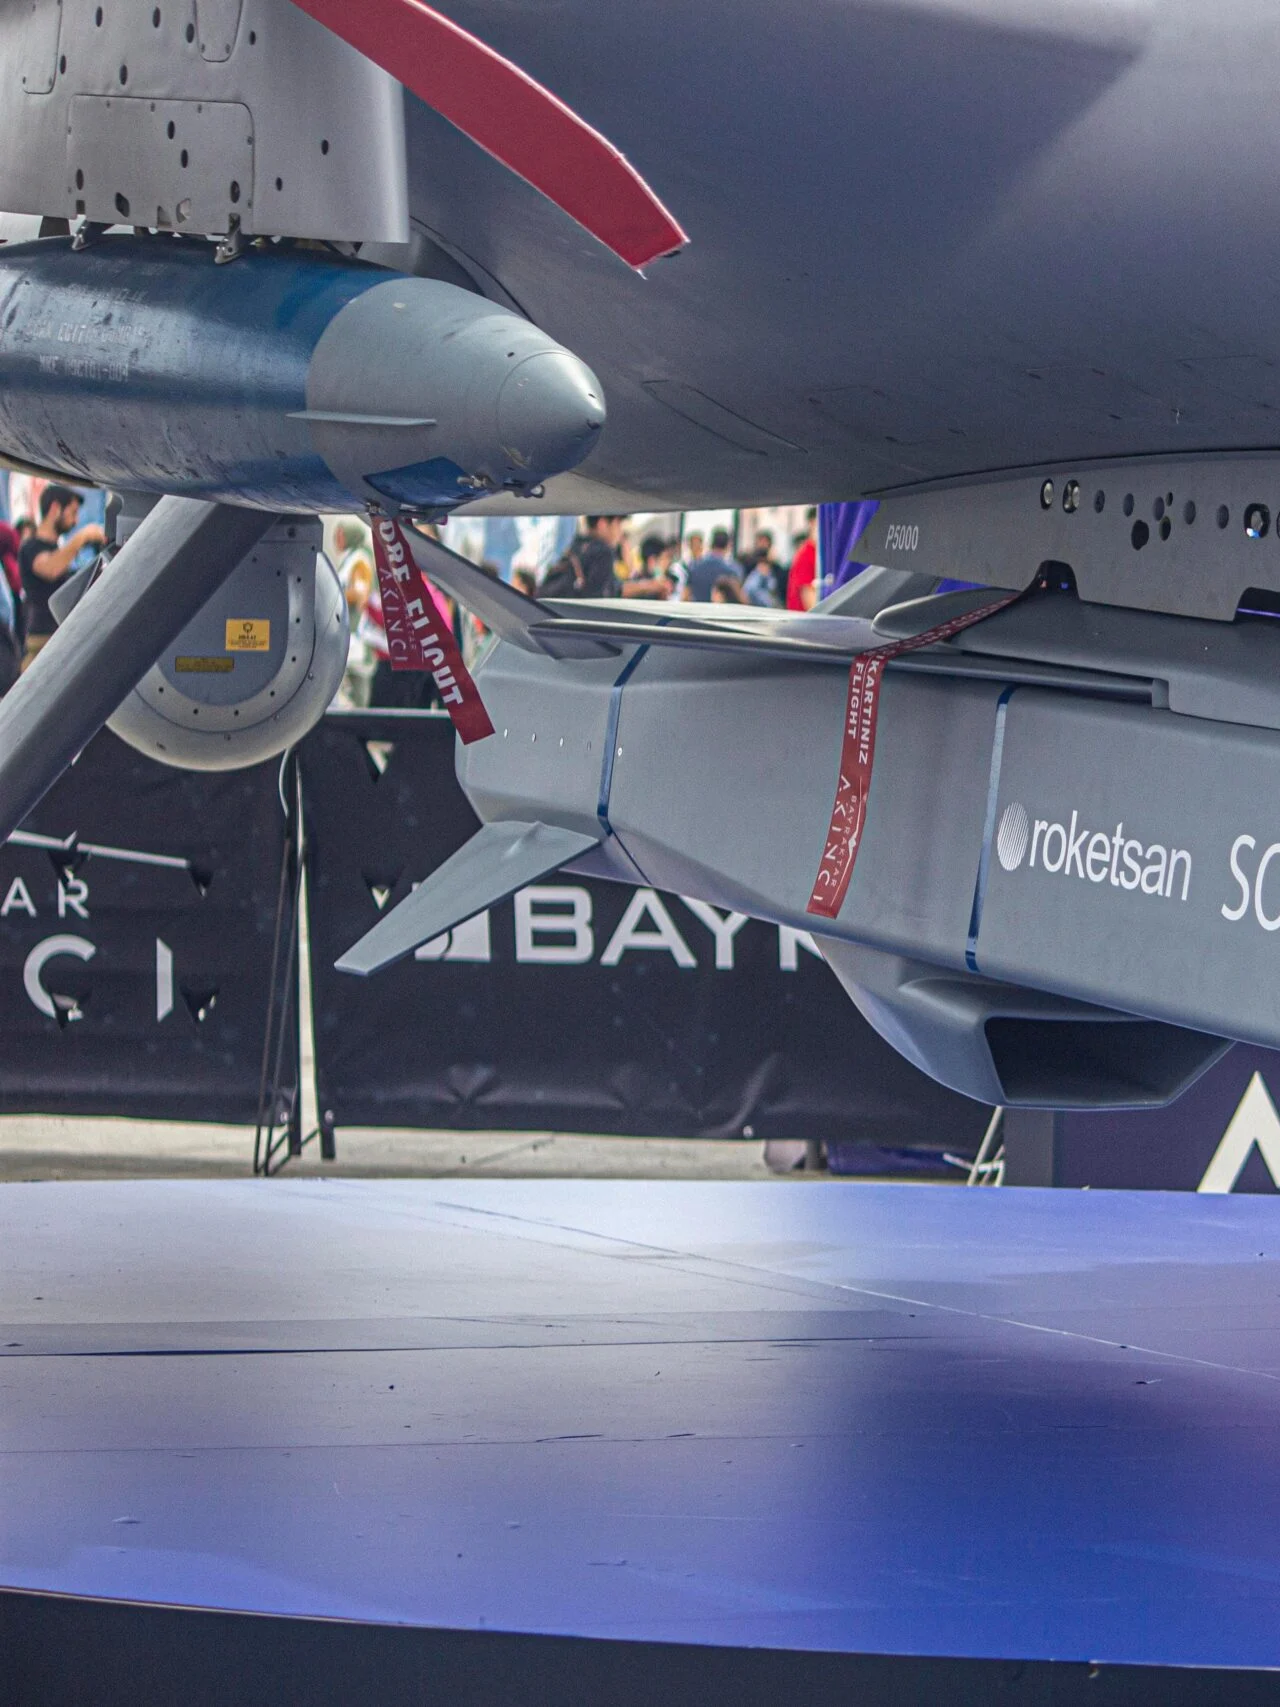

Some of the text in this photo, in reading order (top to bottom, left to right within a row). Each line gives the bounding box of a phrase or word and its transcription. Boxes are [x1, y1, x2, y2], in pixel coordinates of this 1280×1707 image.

[885, 524, 919, 551] P5000
[848, 662, 865, 740] FLIGHT
[813, 775, 851, 900] AKINCI
[831, 795, 857, 887] BAYRAKTAR
[1029, 810, 1192, 901] roketsan
